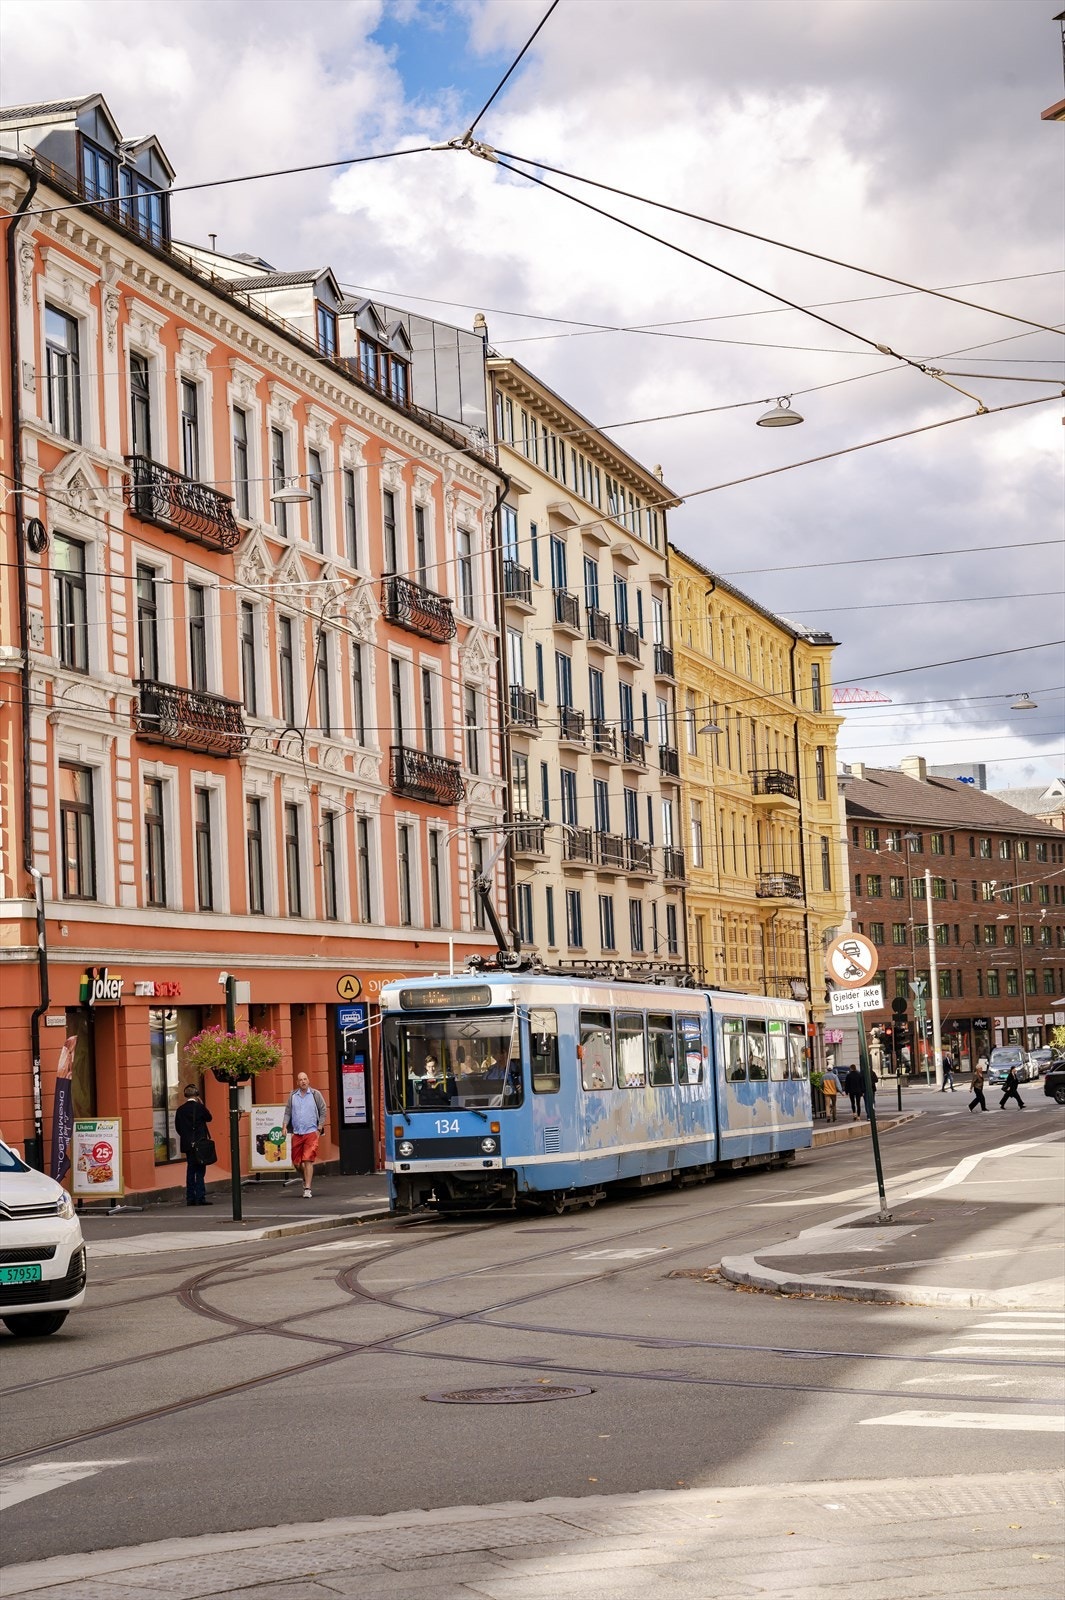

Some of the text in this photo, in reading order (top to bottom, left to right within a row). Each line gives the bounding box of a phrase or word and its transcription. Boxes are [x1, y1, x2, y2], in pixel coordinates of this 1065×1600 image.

[89, 967, 124, 1006] joker
[344, 980, 354, 992] A
[833, 989, 879, 1002] Gjelder ikke
[835, 1003, 854, 1011] buss
[434, 1119, 460, 1134] 134
